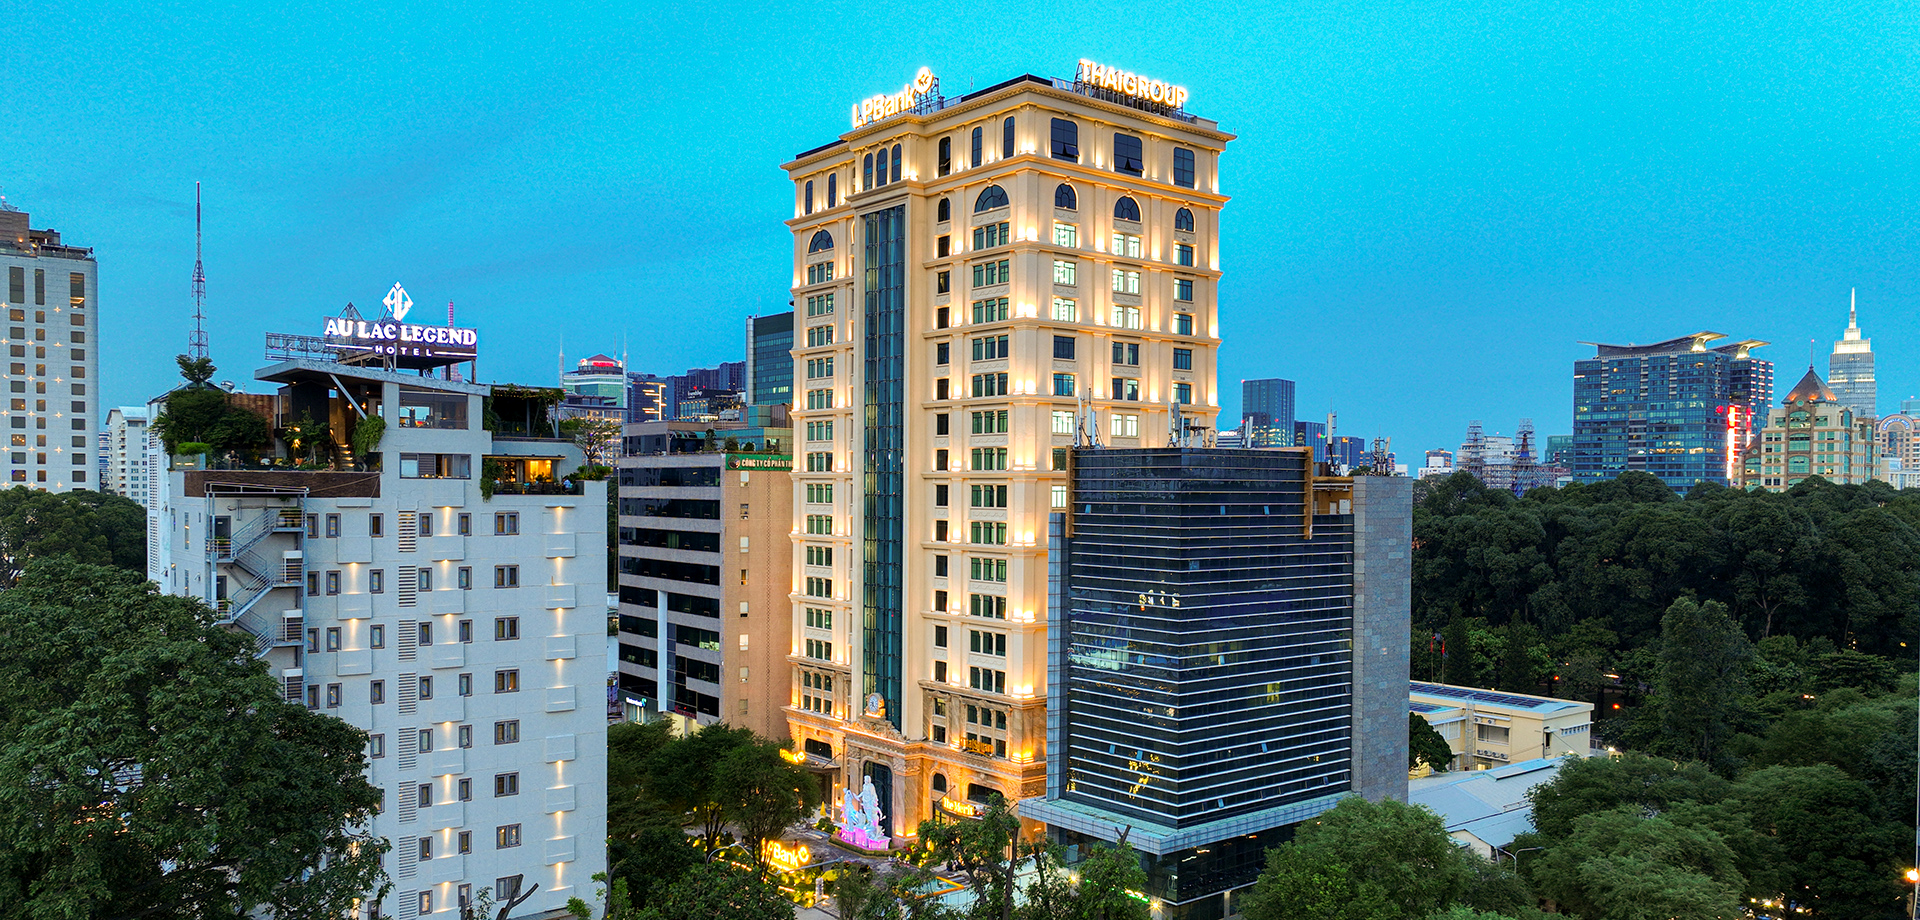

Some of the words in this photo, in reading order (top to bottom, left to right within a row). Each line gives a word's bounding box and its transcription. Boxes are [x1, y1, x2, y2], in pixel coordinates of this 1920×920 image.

[1079, 58, 1188, 107] THAIGROUP
[852, 83, 916, 129] LPBank
[324, 319, 354, 337] AU
[357, 322, 397, 340] LAC
[400, 325, 477, 346] LEGEND
[375, 344, 433, 357] HOTEL
